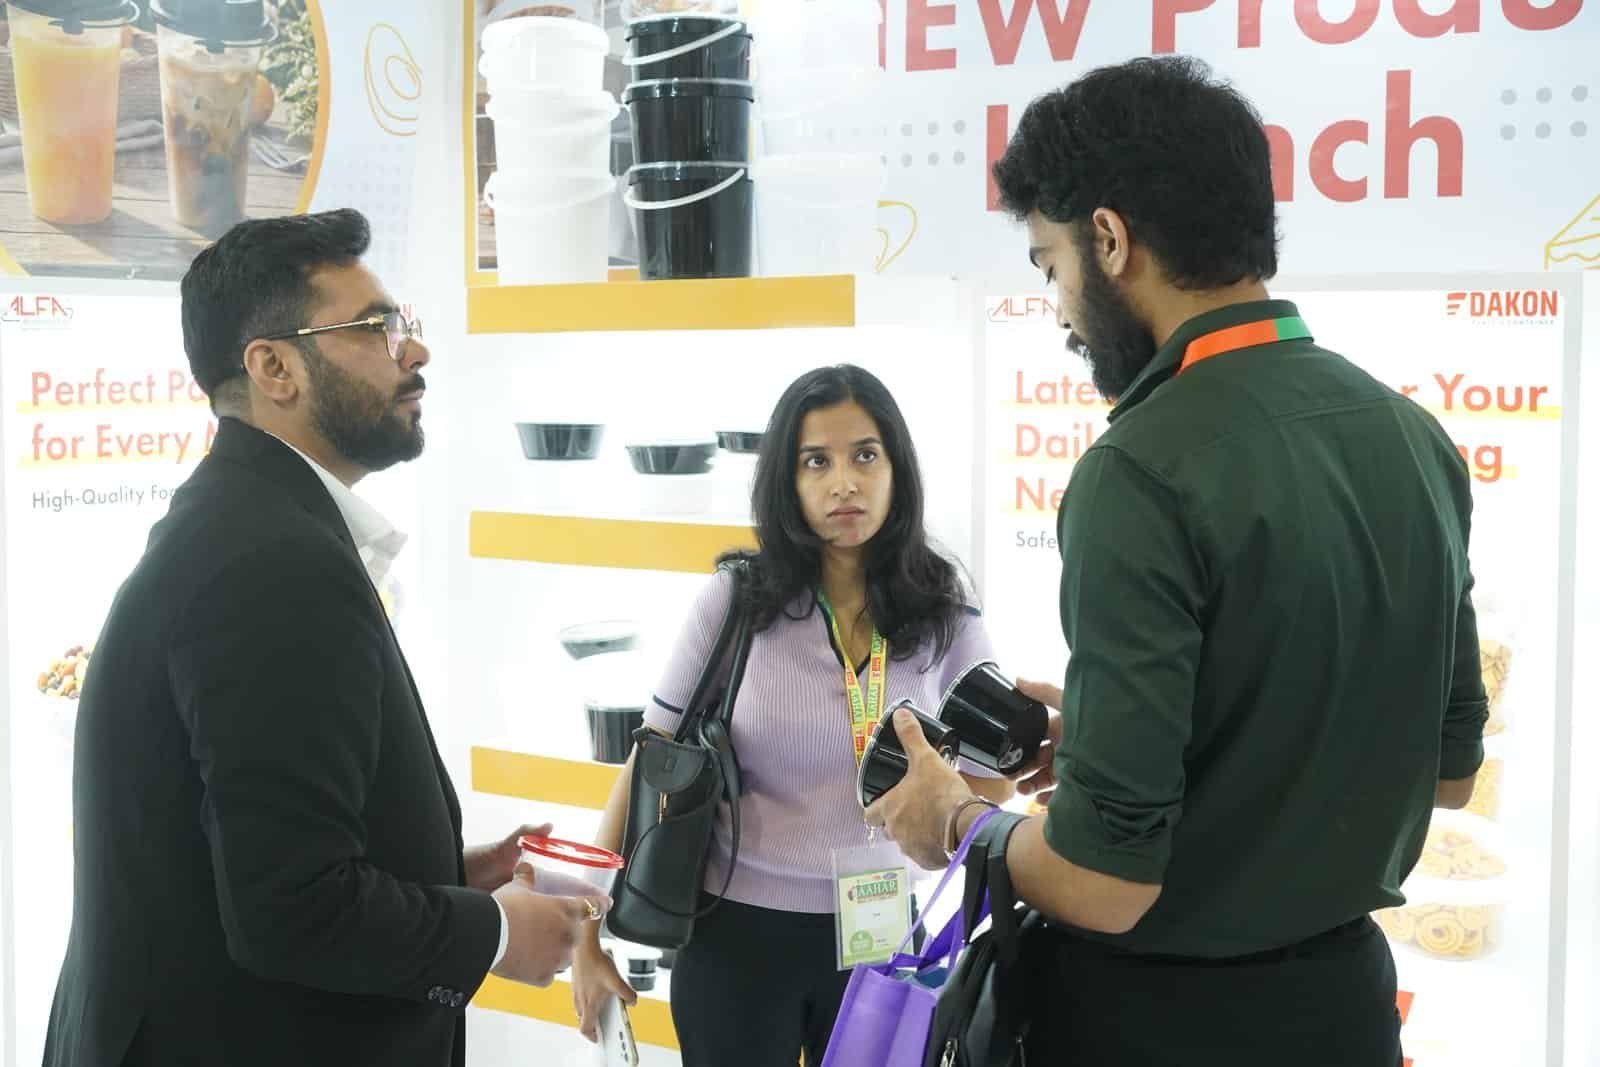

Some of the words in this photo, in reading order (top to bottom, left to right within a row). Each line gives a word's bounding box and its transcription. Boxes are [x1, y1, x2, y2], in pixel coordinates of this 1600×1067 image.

[878, 0, 1092, 72] EW
[1470, 291, 1558, 317] DAKON
[32, 368, 156, 407] Perfect
[1016, 370, 1116, 406] Late
[1433, 373, 1548, 413] Your
[32, 423, 84, 462] for
[97, 424, 192, 464] Every
[1015, 422, 1093, 459] Dail
[33, 486, 144, 512] High-Quality
